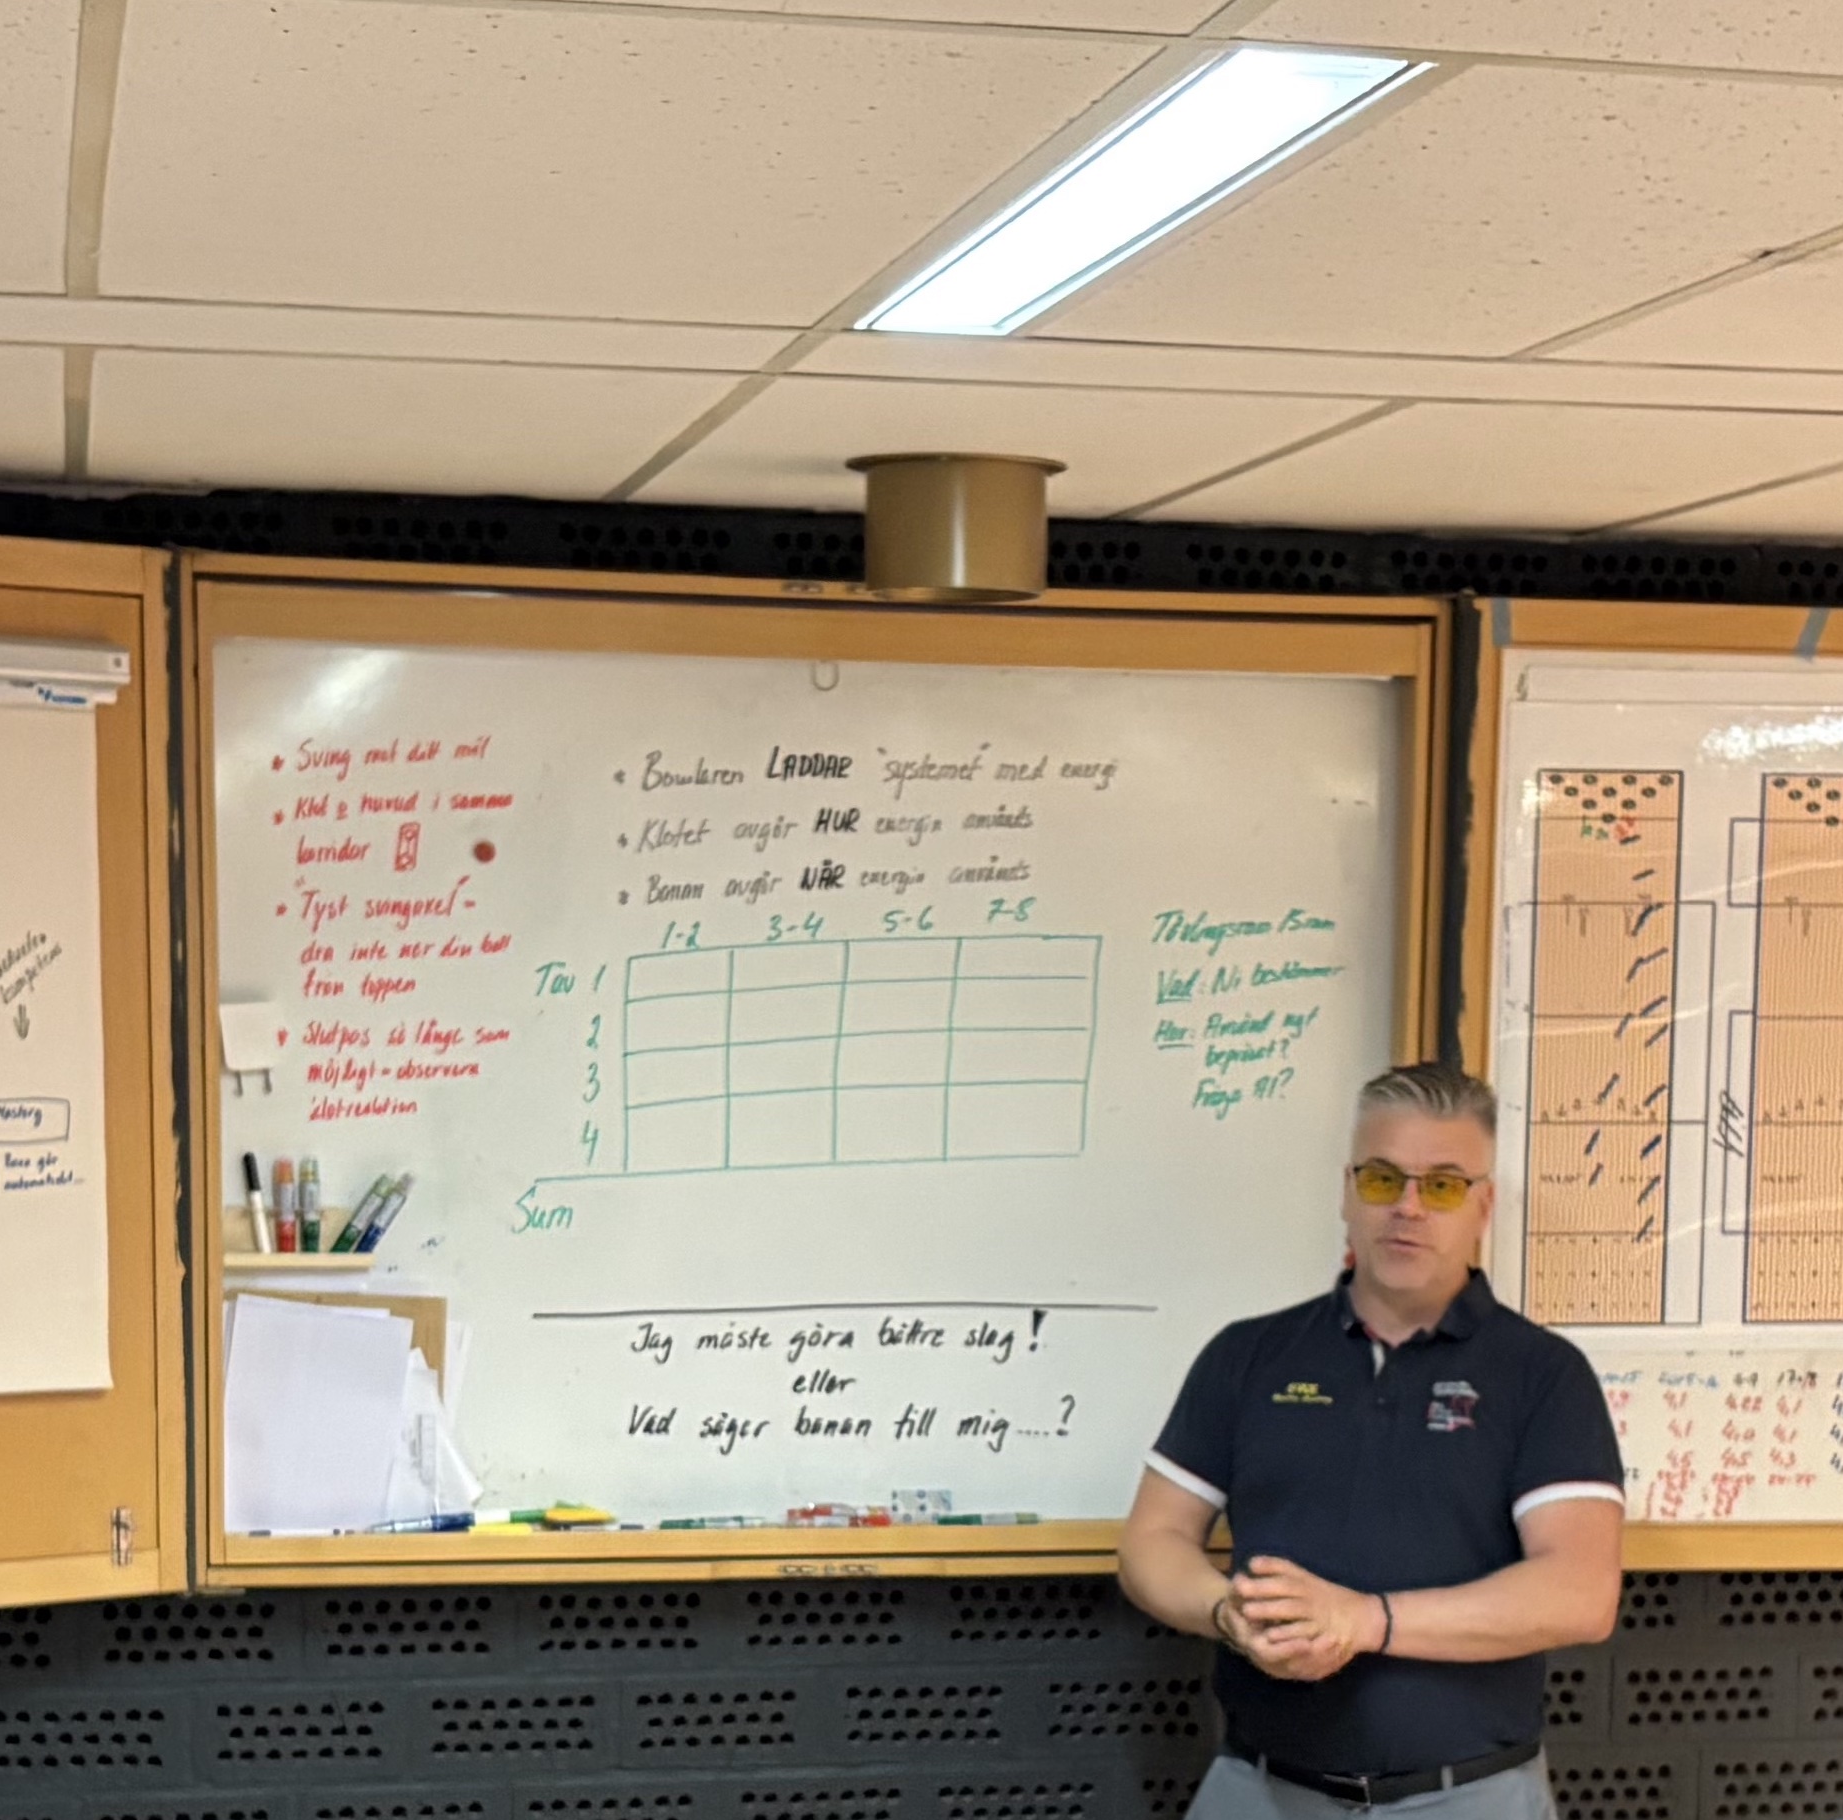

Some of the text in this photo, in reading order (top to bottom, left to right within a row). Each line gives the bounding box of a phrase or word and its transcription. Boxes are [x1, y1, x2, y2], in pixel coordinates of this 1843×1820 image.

[641, 749, 745, 792] Bowlaren
[766, 745, 855, 779] LADDAR
[993, 755, 1046, 781] med
[635, 818, 710, 854] Klotet
[733, 818, 800, 853] avgör
[814, 807, 861, 834] HUR
[800, 859, 846, 891] NÄR
[661, 896, 1037, 950] 1-2 3-4 5-6 7-8
[585, 1014, 602, 1050] 2
[583, 1061, 601, 1102] 3
[580, 1121, 599, 1165] 4
[511, 1185, 574, 1234] Sum
[631, 1321, 675, 1364] Jag
[697, 1322, 773, 1351] måste
[788, 1323, 854, 1363] göra
[878, 1316, 946, 1348] bättre
[792, 1371, 855, 1396] eller
[629, 1403, 676, 1439] Vad
[699, 1407, 770, 1455] säger
[794, 1407, 872, 1439] banan
[893, 1403, 934, 1441] till
